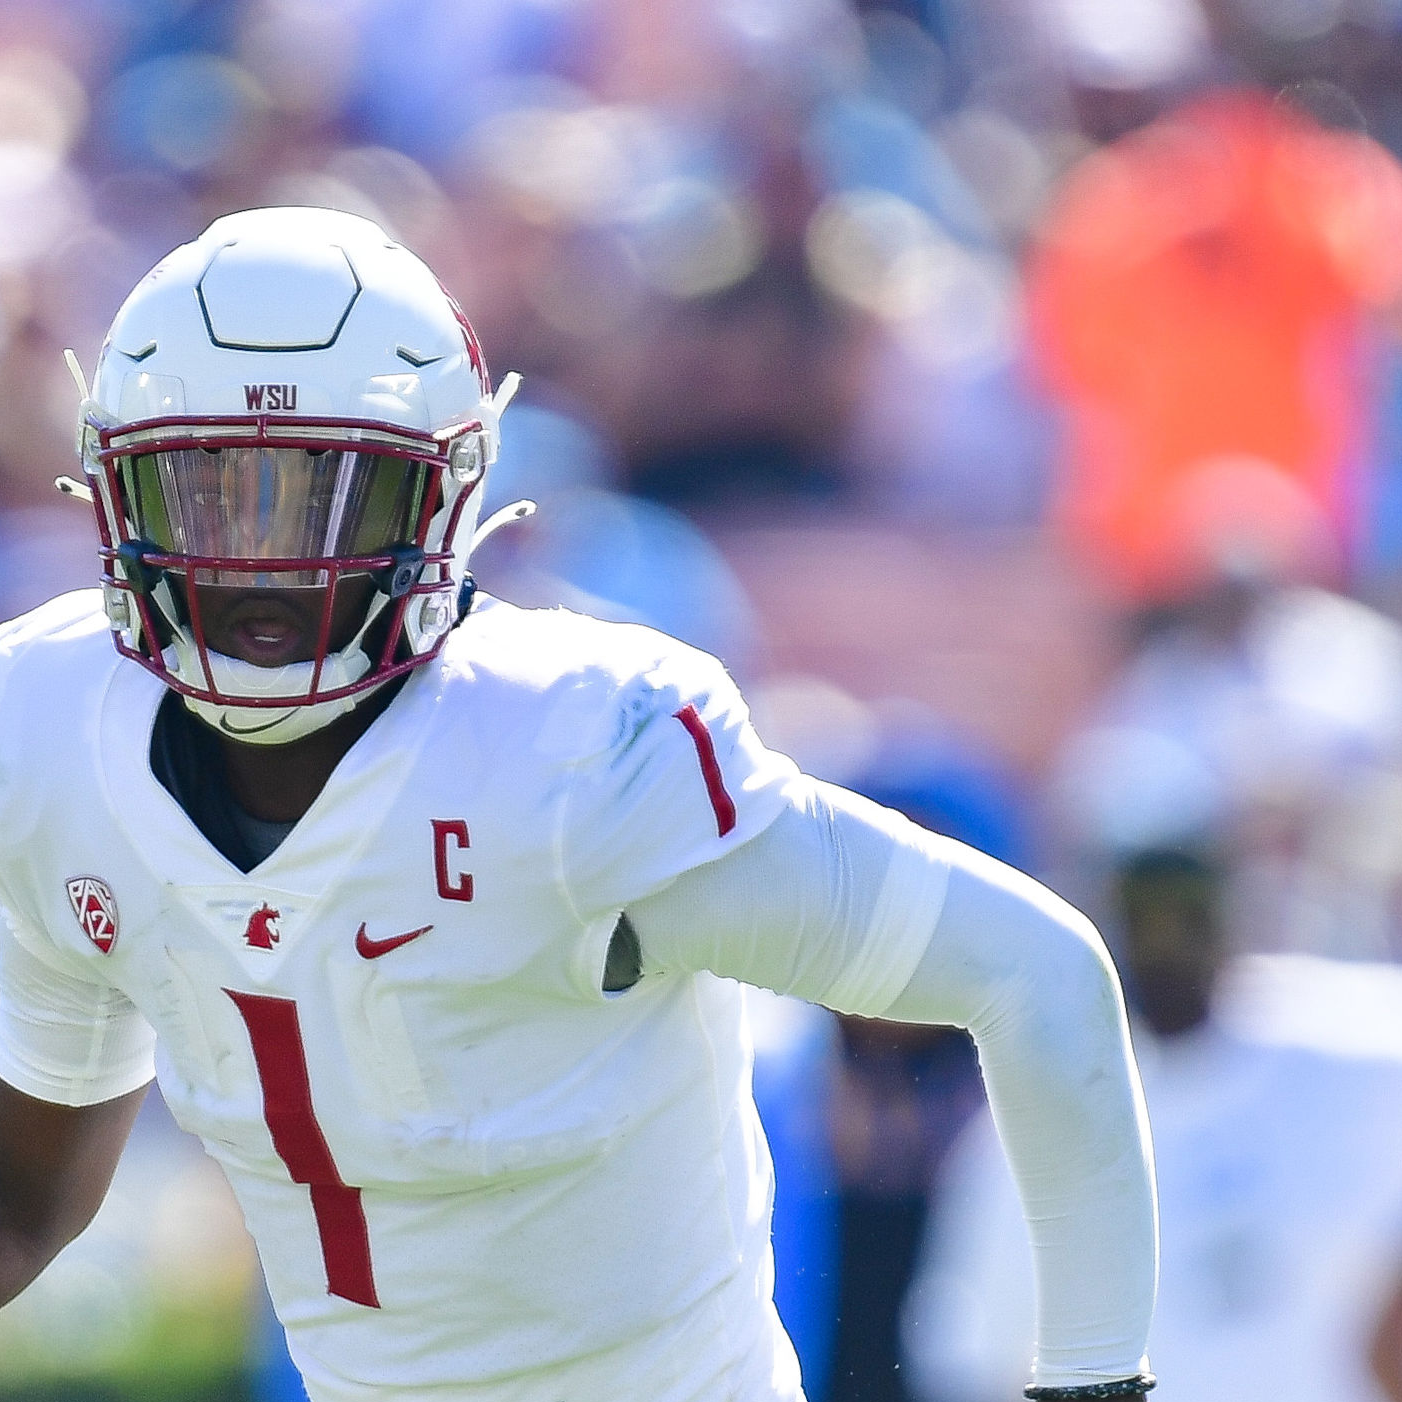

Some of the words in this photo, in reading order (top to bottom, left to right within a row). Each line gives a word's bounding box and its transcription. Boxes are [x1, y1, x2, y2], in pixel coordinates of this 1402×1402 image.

[243, 384, 297, 411] WSU
[671, 703, 737, 838] 1
[429, 818, 474, 903] C
[67, 879, 115, 925] PAC
[85, 909, 114, 941] 12
[220, 986, 382, 1310] 1
